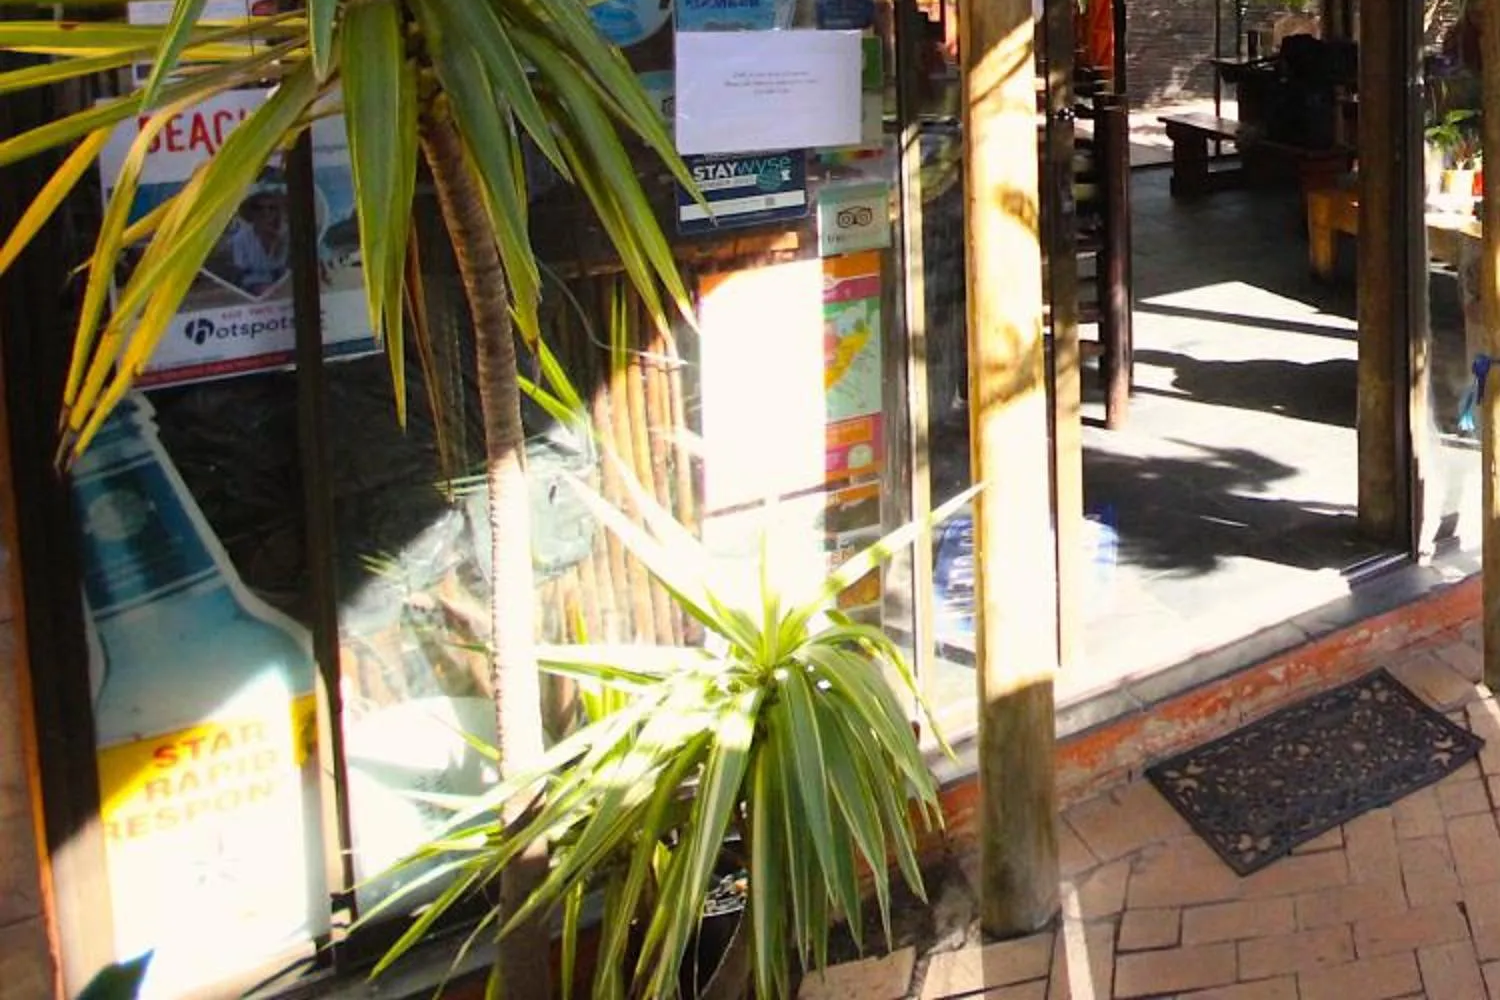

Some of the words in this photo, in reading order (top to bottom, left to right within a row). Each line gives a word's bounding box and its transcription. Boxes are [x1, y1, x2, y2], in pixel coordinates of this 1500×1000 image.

[137, 107, 247, 157] BEAC
[153, 721, 264, 769] STAR
[144, 749, 277, 803] RAPID
